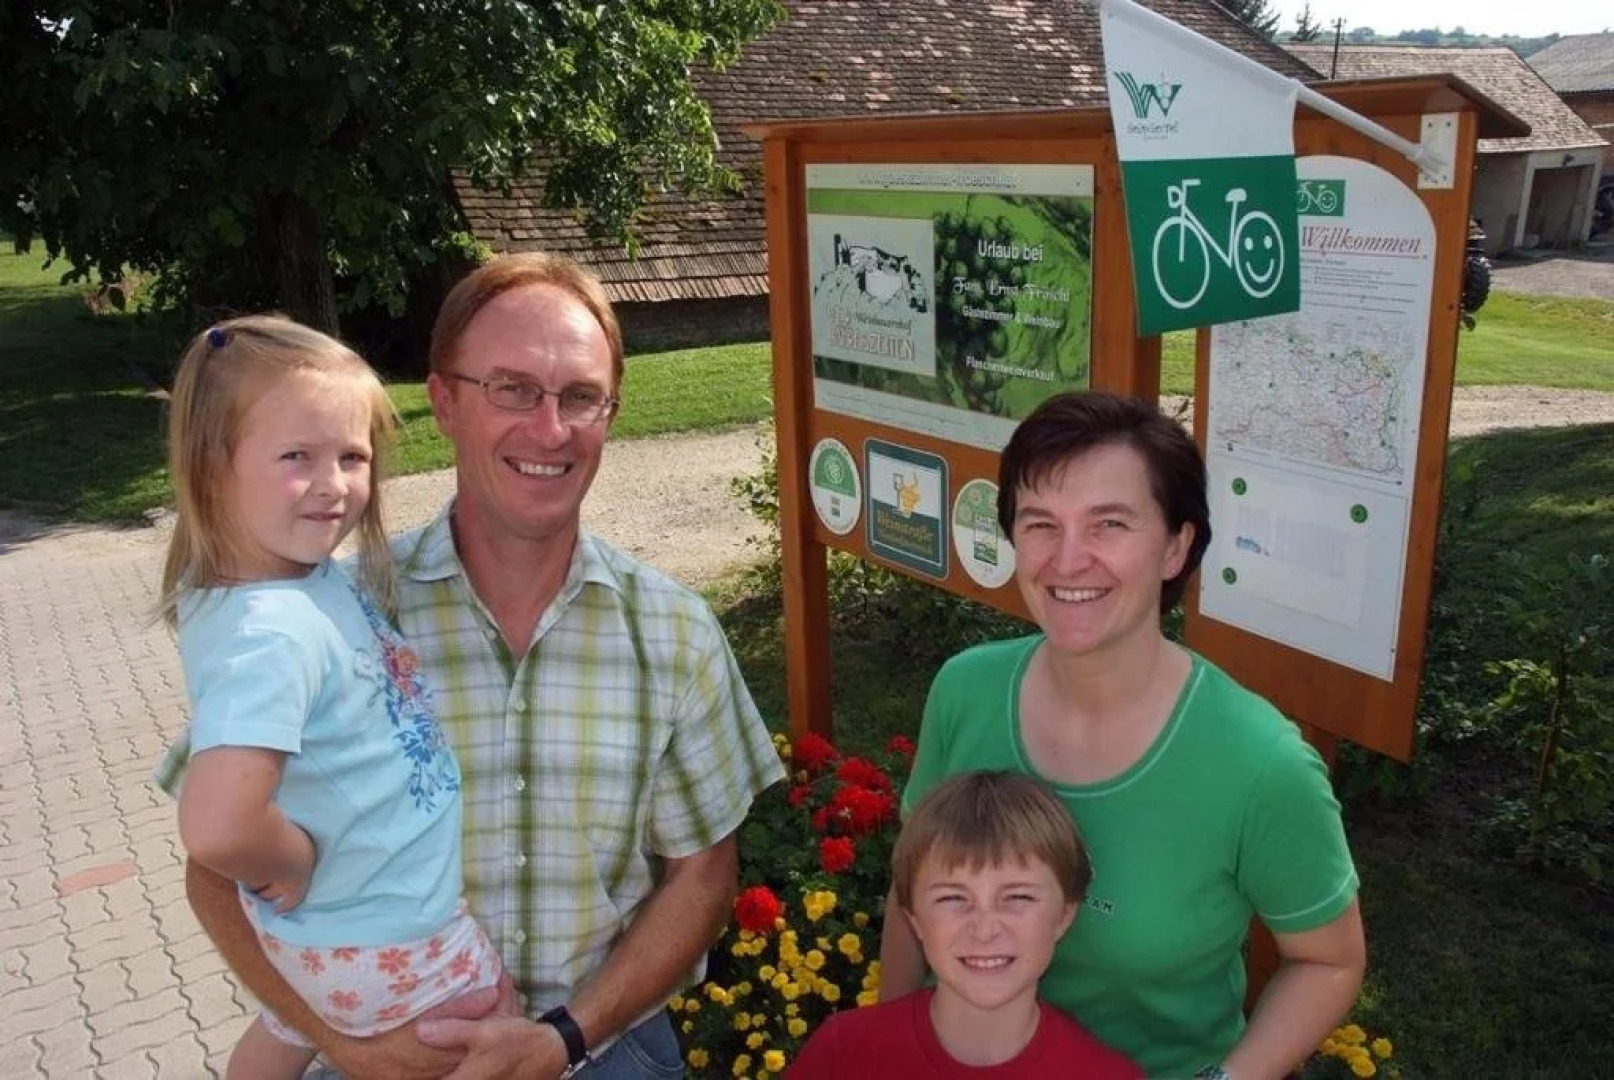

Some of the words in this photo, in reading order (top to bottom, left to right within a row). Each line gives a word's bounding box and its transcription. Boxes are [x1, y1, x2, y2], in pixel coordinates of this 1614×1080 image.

[978, 238, 1019, 260] Urlaub
[1022, 243, 1043, 262] bei
[1301, 226, 1421, 253] Willkommen
